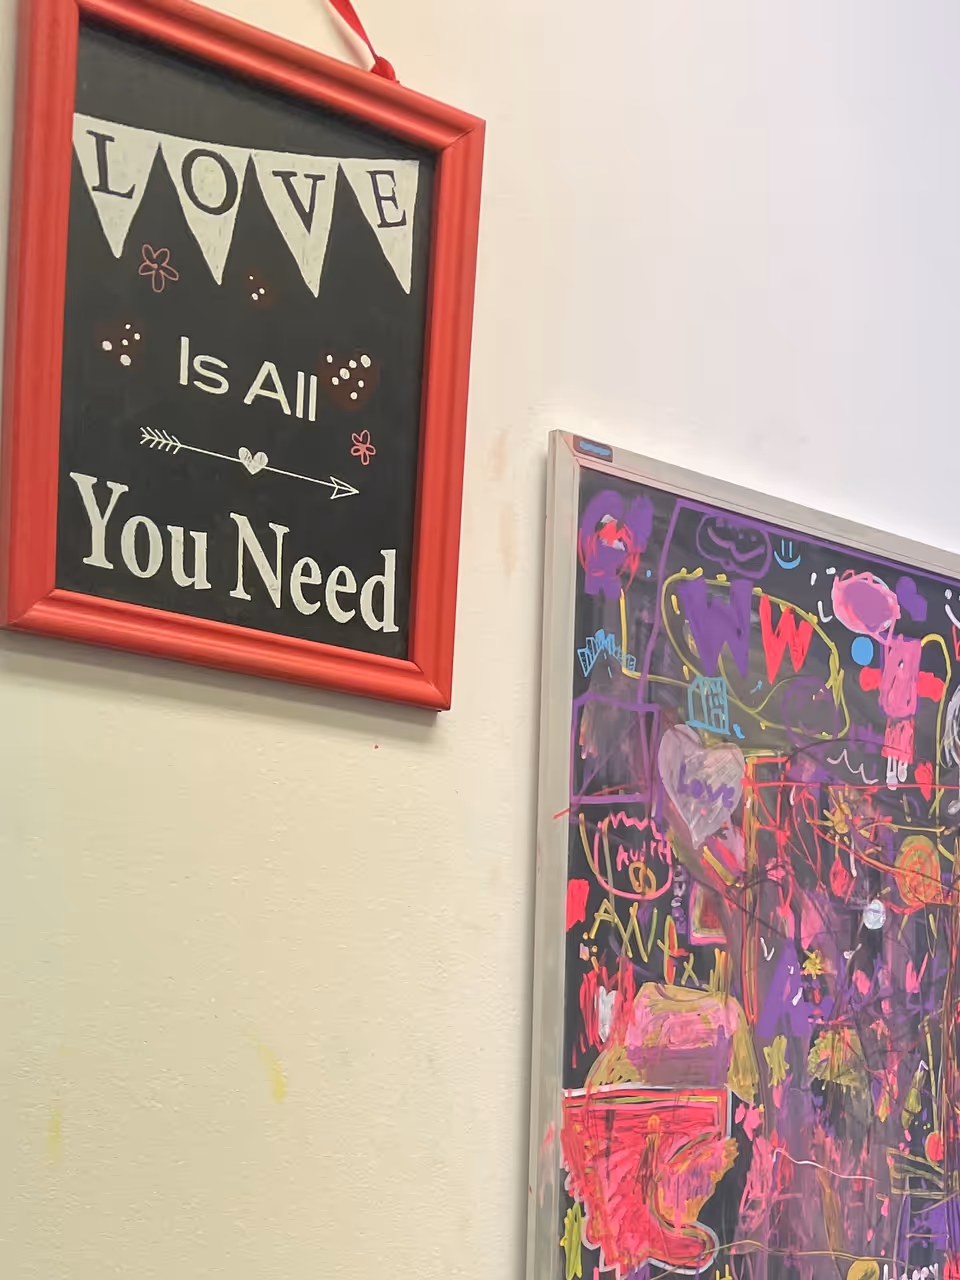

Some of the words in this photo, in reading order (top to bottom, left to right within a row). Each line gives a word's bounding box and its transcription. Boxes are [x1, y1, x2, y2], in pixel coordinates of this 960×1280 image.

[86, 129, 407, 229] LOVE
[180, 336, 229, 395] Is
[243, 360, 317, 422] All
[69, 471, 212, 590] You
[229, 512, 399, 633] Need
